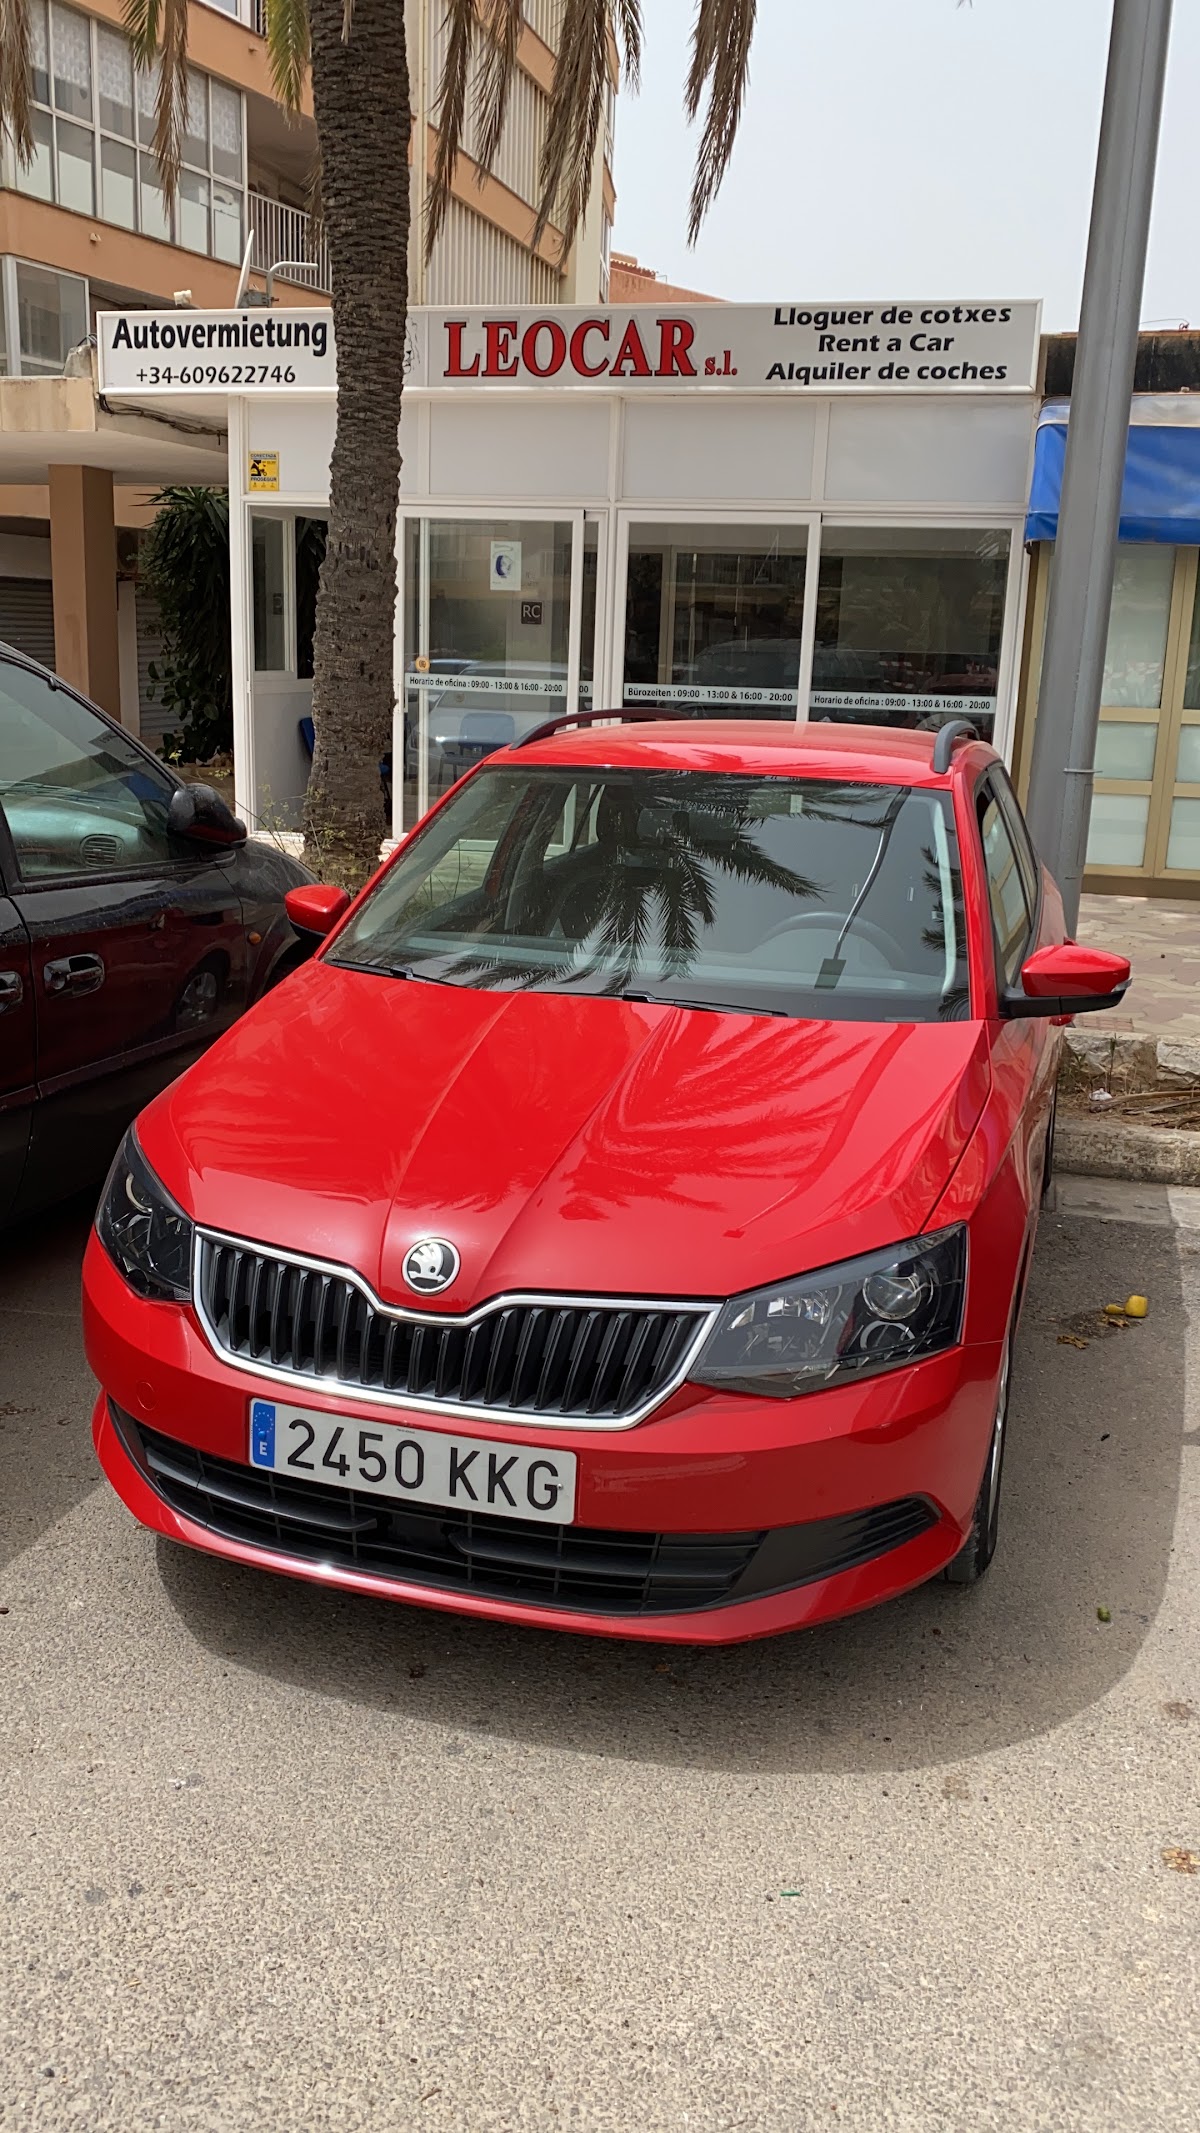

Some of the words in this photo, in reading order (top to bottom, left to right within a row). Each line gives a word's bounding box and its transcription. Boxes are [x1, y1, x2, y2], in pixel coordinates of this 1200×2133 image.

[774, 307, 874, 330] Lloguer
[880, 306, 913, 324] de
[920, 306, 1012, 324] cotxes
[111, 315, 328, 357] Autovermietung
[818, 334, 880, 352] Rent
[886, 337, 902, 352] a
[909, 333, 955, 352] Car
[443, 319, 697, 377] LEOCAR
[704, 350, 738, 376] s.l.
[136, 365, 296, 385] +34-609622746
[765, 362, 871, 385] Alquiler
[878, 361, 910, 380] de
[917, 361, 1008, 380] coches
[522, 604, 541, 618] RC
[409, 676, 434, 686] Horario
[435, 677, 444, 686] de
[444, 678, 467, 688] oficina
[471, 680, 490, 689] 09:00
[495, 681, 513, 690] 13:00
[513, 682, 520, 690] &
[520, 683, 539, 691] 16:00
[544, 683, 563, 692] 20:00
[628, 687, 671, 697] Bürozeiten
[677, 689, 700, 698] 09:00
[707, 690, 730, 699] 13:00
[731, 691, 738, 699] &
[740, 692, 763, 700] 16:00
[769, 692, 793, 701] 20:00
[814, 695, 842, 704] Horario
[843, 696, 853, 705] de
[854, 696, 880, 706] oficina
[885, 698, 906, 707] 09:00
[912, 699, 933, 708] 13:00
[934, 699, 941, 708] &
[942, 700, 963, 708] 16:00
[969, 700, 991, 709] 20:00
[259, 1441, 268, 1456] E
[287, 1418, 425, 1490] 2450
[449, 1446, 559, 1511] KKG
